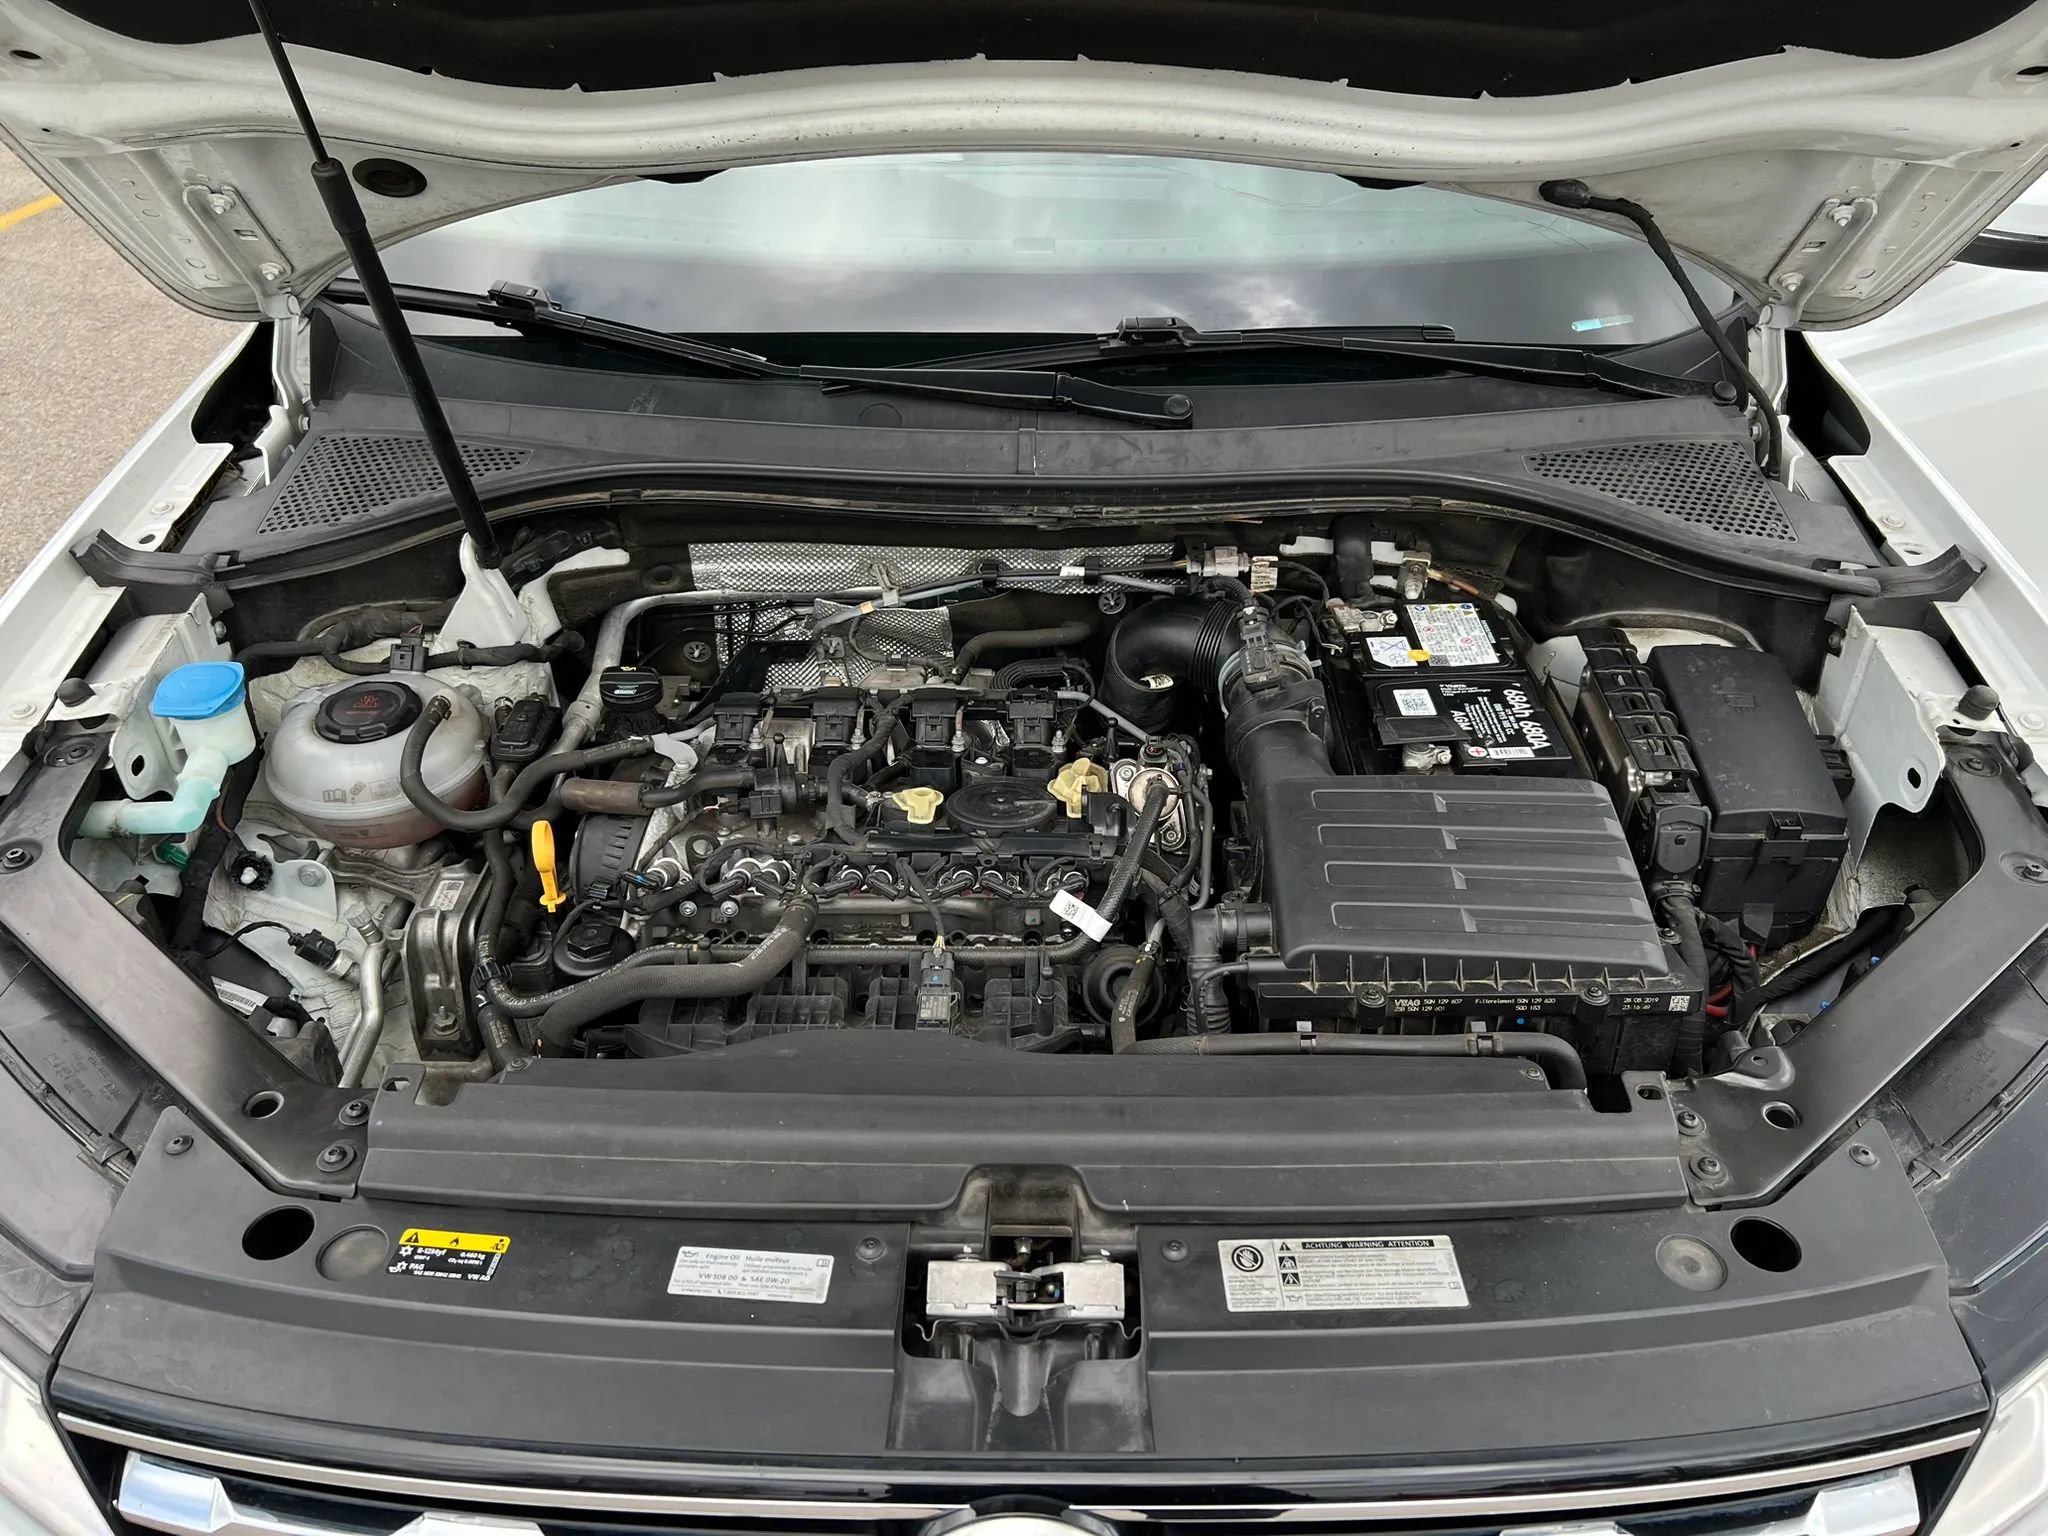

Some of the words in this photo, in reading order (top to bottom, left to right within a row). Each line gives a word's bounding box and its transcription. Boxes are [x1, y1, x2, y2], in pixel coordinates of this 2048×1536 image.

[1450, 710, 1473, 730] AGM
[1503, 689, 1534, 718] 68Ah
[1519, 720, 1552, 749] 680A
[705, 1253, 729, 1261] Engine
